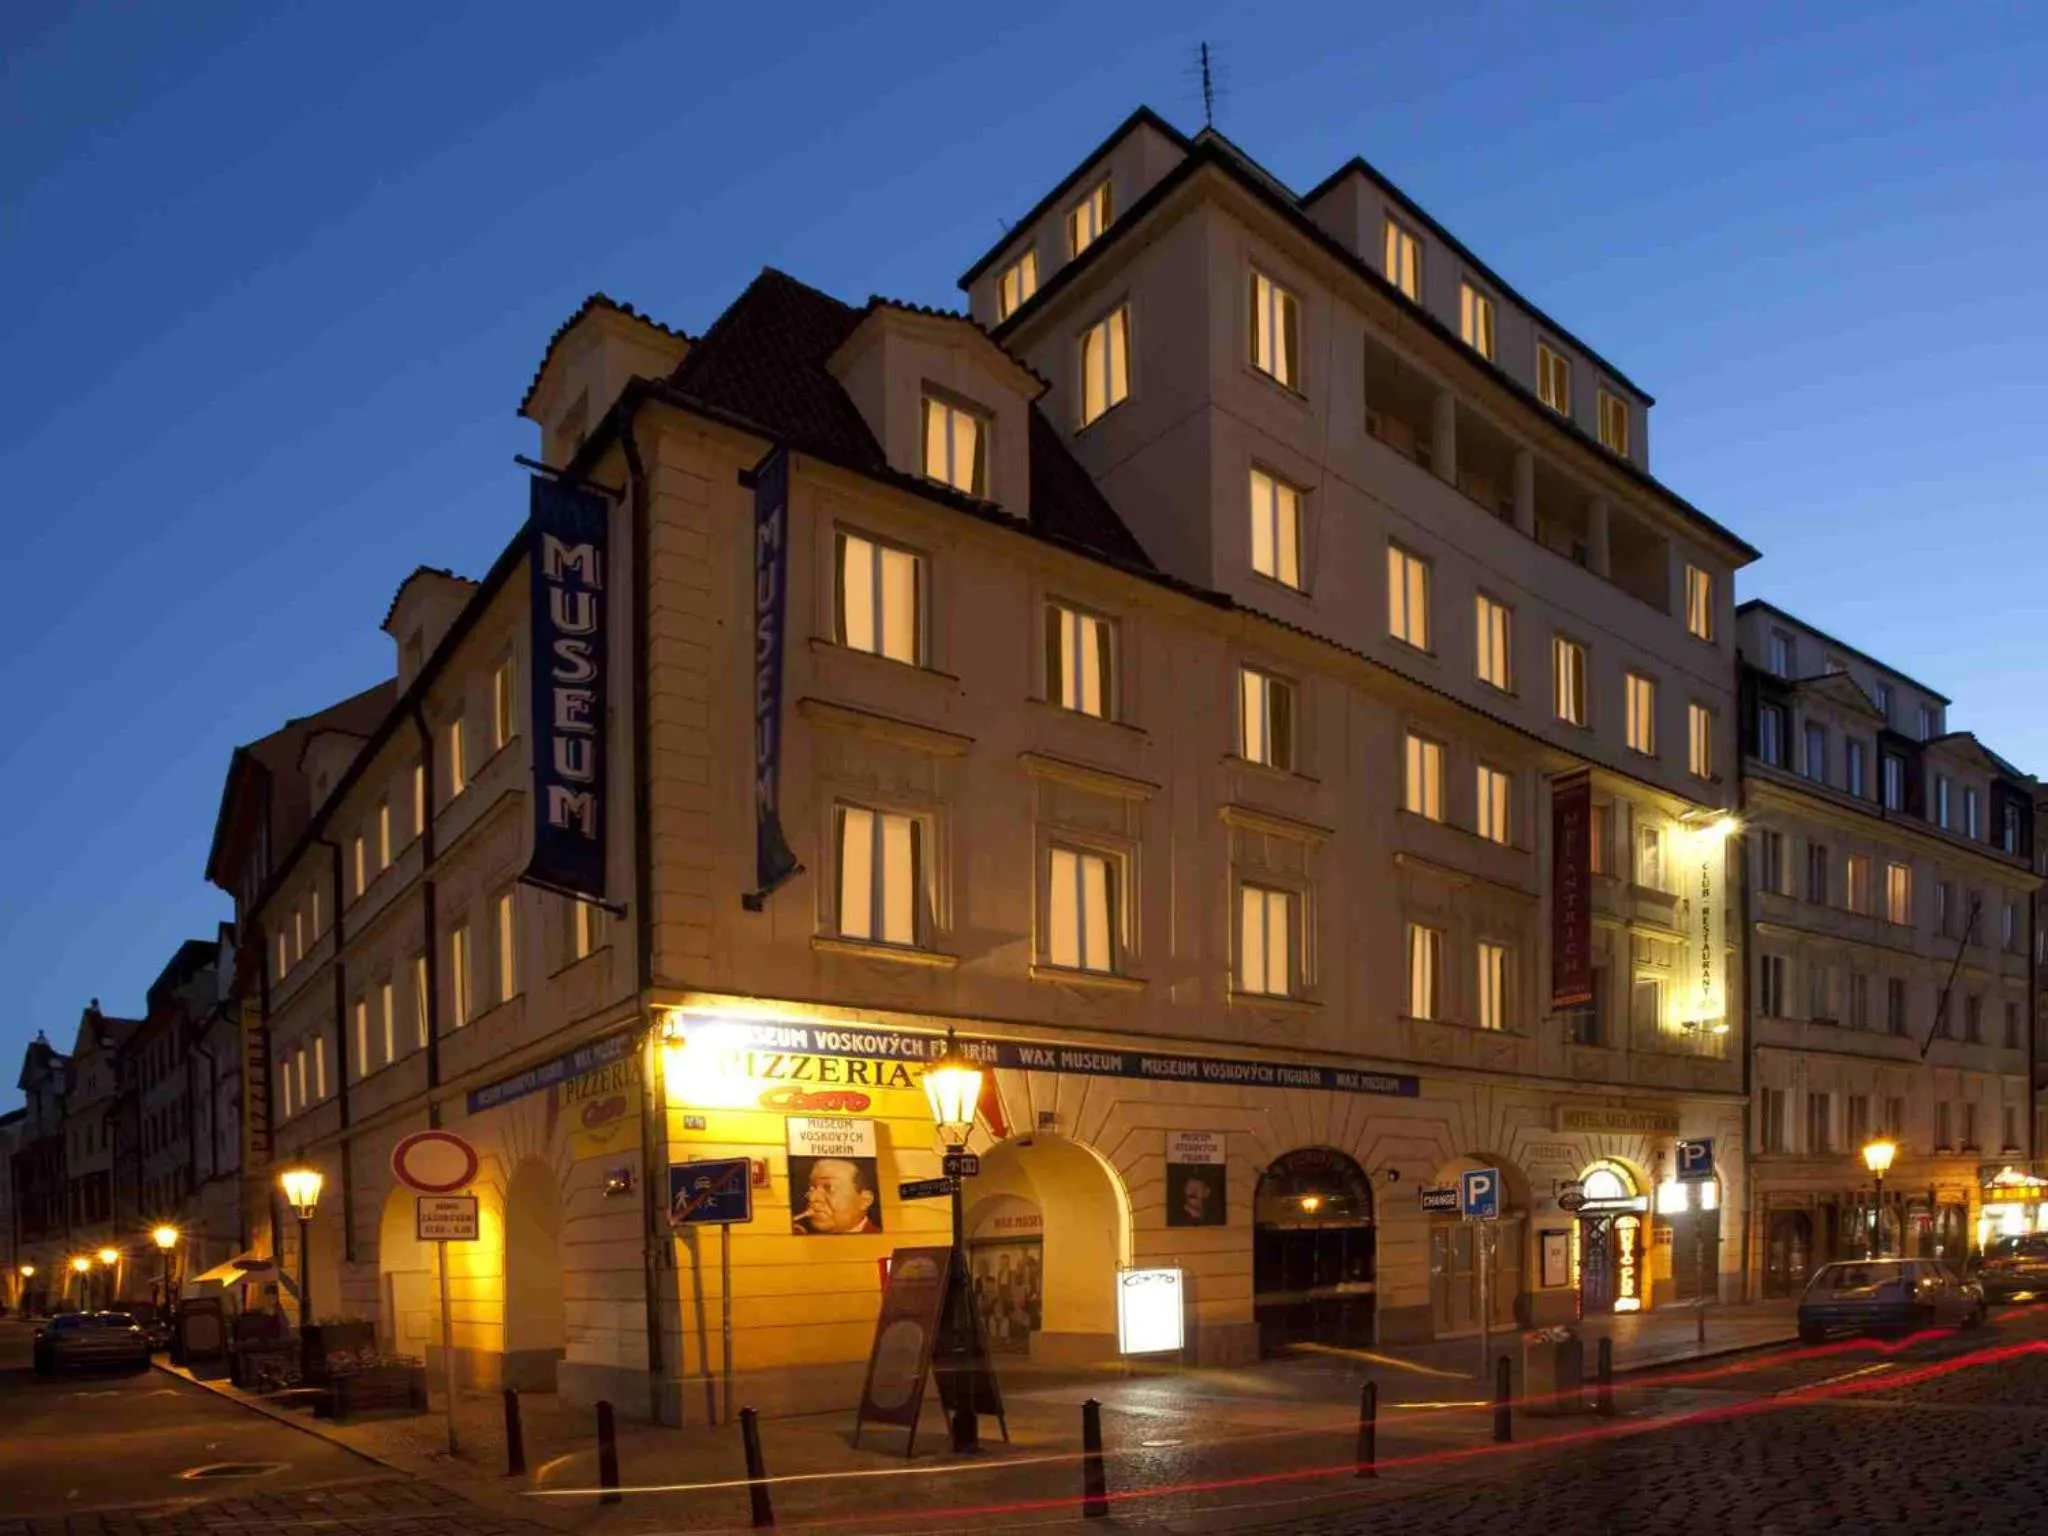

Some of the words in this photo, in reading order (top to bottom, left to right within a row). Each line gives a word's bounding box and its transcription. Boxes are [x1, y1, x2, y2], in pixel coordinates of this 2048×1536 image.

[757, 506, 782, 819] MUSEUM
[541, 532, 602, 839] MUSEUM
[815, 1029, 924, 1057] VOSKOVÝCH
[1019, 1048, 1055, 1068] WAX
[1061, 1050, 1123, 1071] MUSEUM
[566, 1060, 642, 1104] PIZZERIA
[718, 1051, 916, 1088] PIZZERIA
[1141, 1057, 1198, 1077] MUSEUM
[1201, 1061, 1274, 1083] VOSKOVÝCH
[1336, 1074, 1360, 1088] WAX
[800, 1130, 864, 1142] VOSKOVÝCH
[807, 1118, 853, 1131] MUSEUM
[811, 1142, 854, 1155] FIGURÍN
[1684, 1145, 1706, 1169] P
[1423, 1193, 1457, 1208] CHANGE
[1469, 1176, 1491, 1205] P
